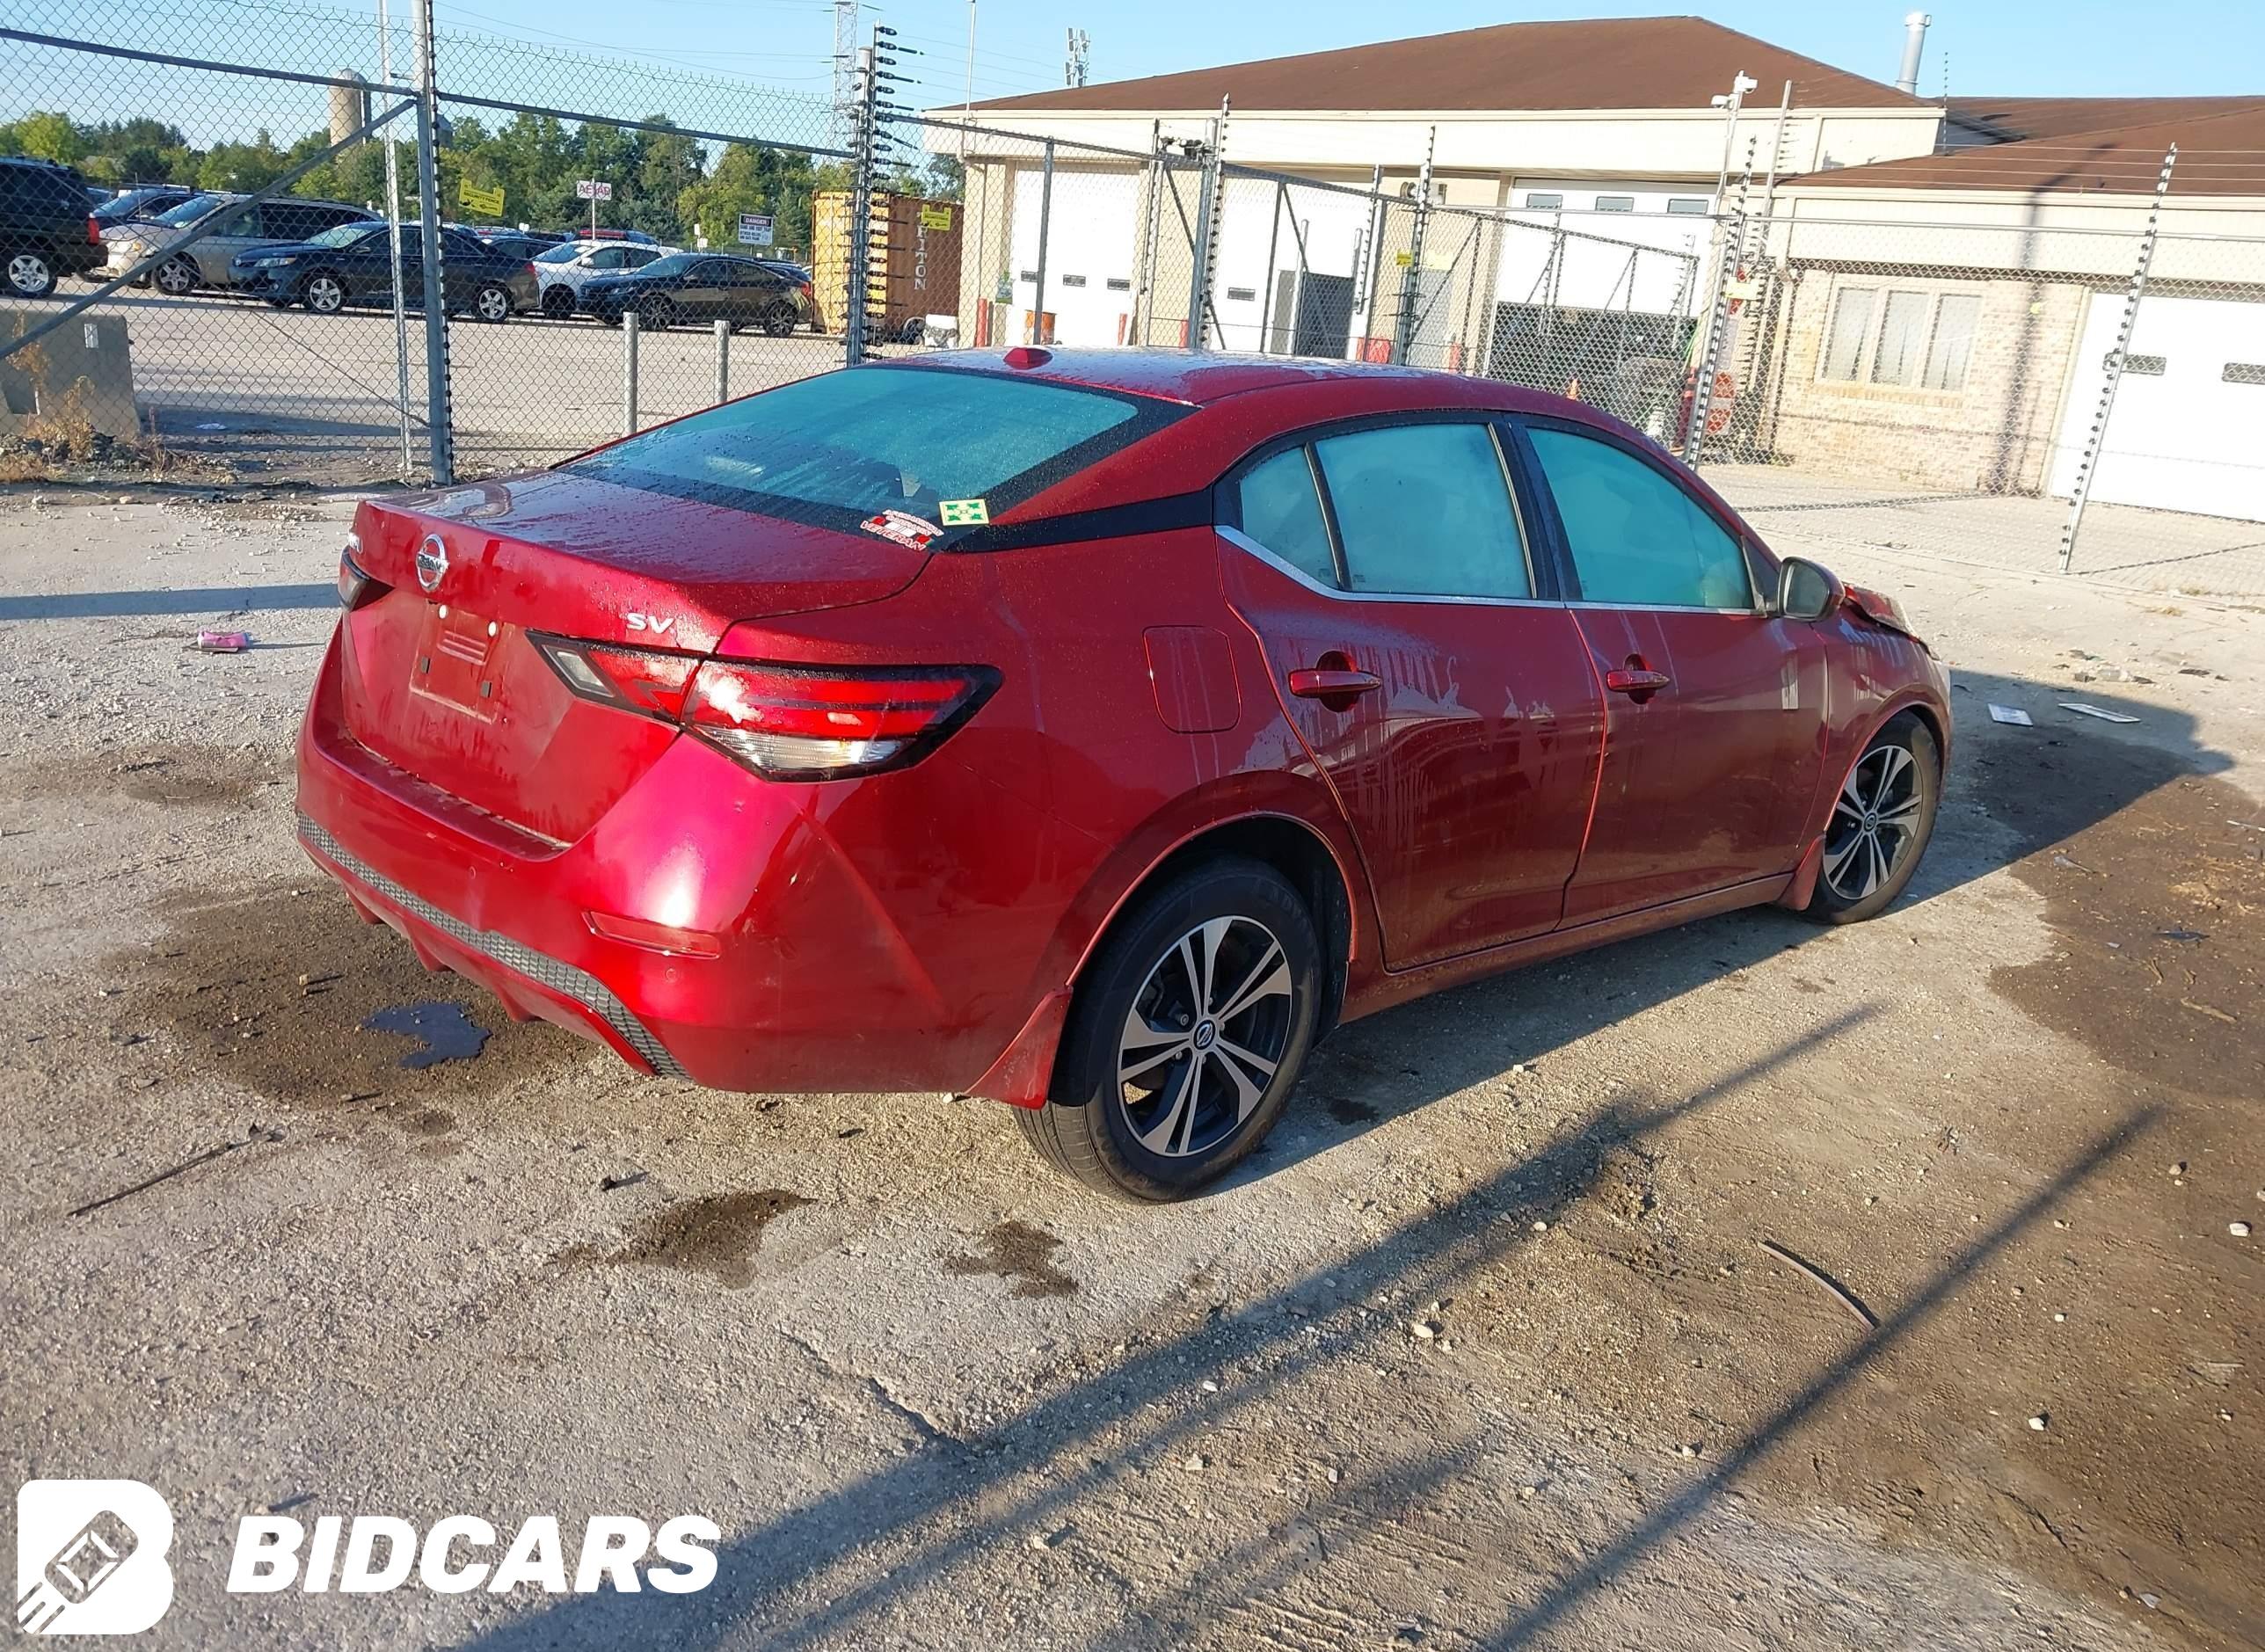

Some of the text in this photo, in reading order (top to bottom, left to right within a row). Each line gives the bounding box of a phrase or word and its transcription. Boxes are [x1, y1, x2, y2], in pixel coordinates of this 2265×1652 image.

[914, 212, 929, 290] RITON
[860, 520, 927, 551] VETERAN
[626, 612, 674, 634] SV
